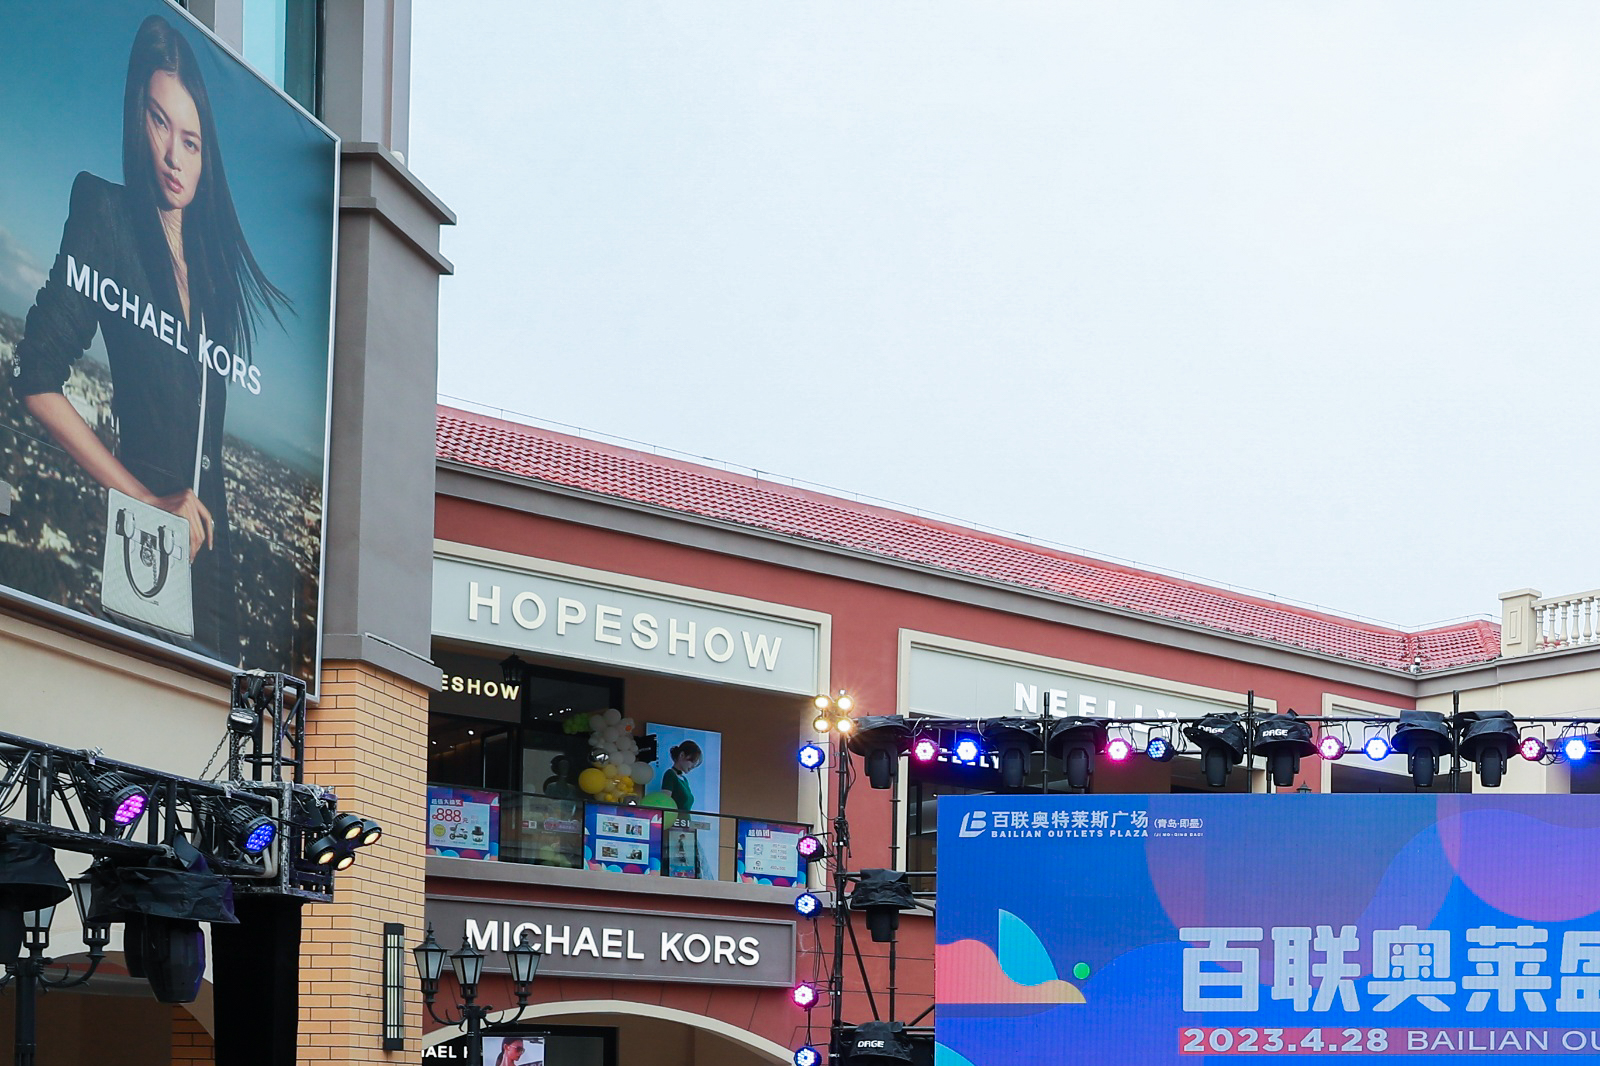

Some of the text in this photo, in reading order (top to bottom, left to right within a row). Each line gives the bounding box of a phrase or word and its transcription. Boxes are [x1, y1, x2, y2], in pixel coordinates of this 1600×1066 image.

[66, 253, 262, 396] MICHAEL KORS
[469, 581, 782, 671] HOPESHOW
[991, 810, 1149, 829] 百联奥特莱斯广场
[991, 830, 1149, 838] BAILIAN OUTLETS PLAZA
[465, 918, 760, 967] MICHAEL KORS
[1183, 1027, 1389, 1052] 2023.4.28
[1407, 1030, 1549, 1051] BAILIAN
